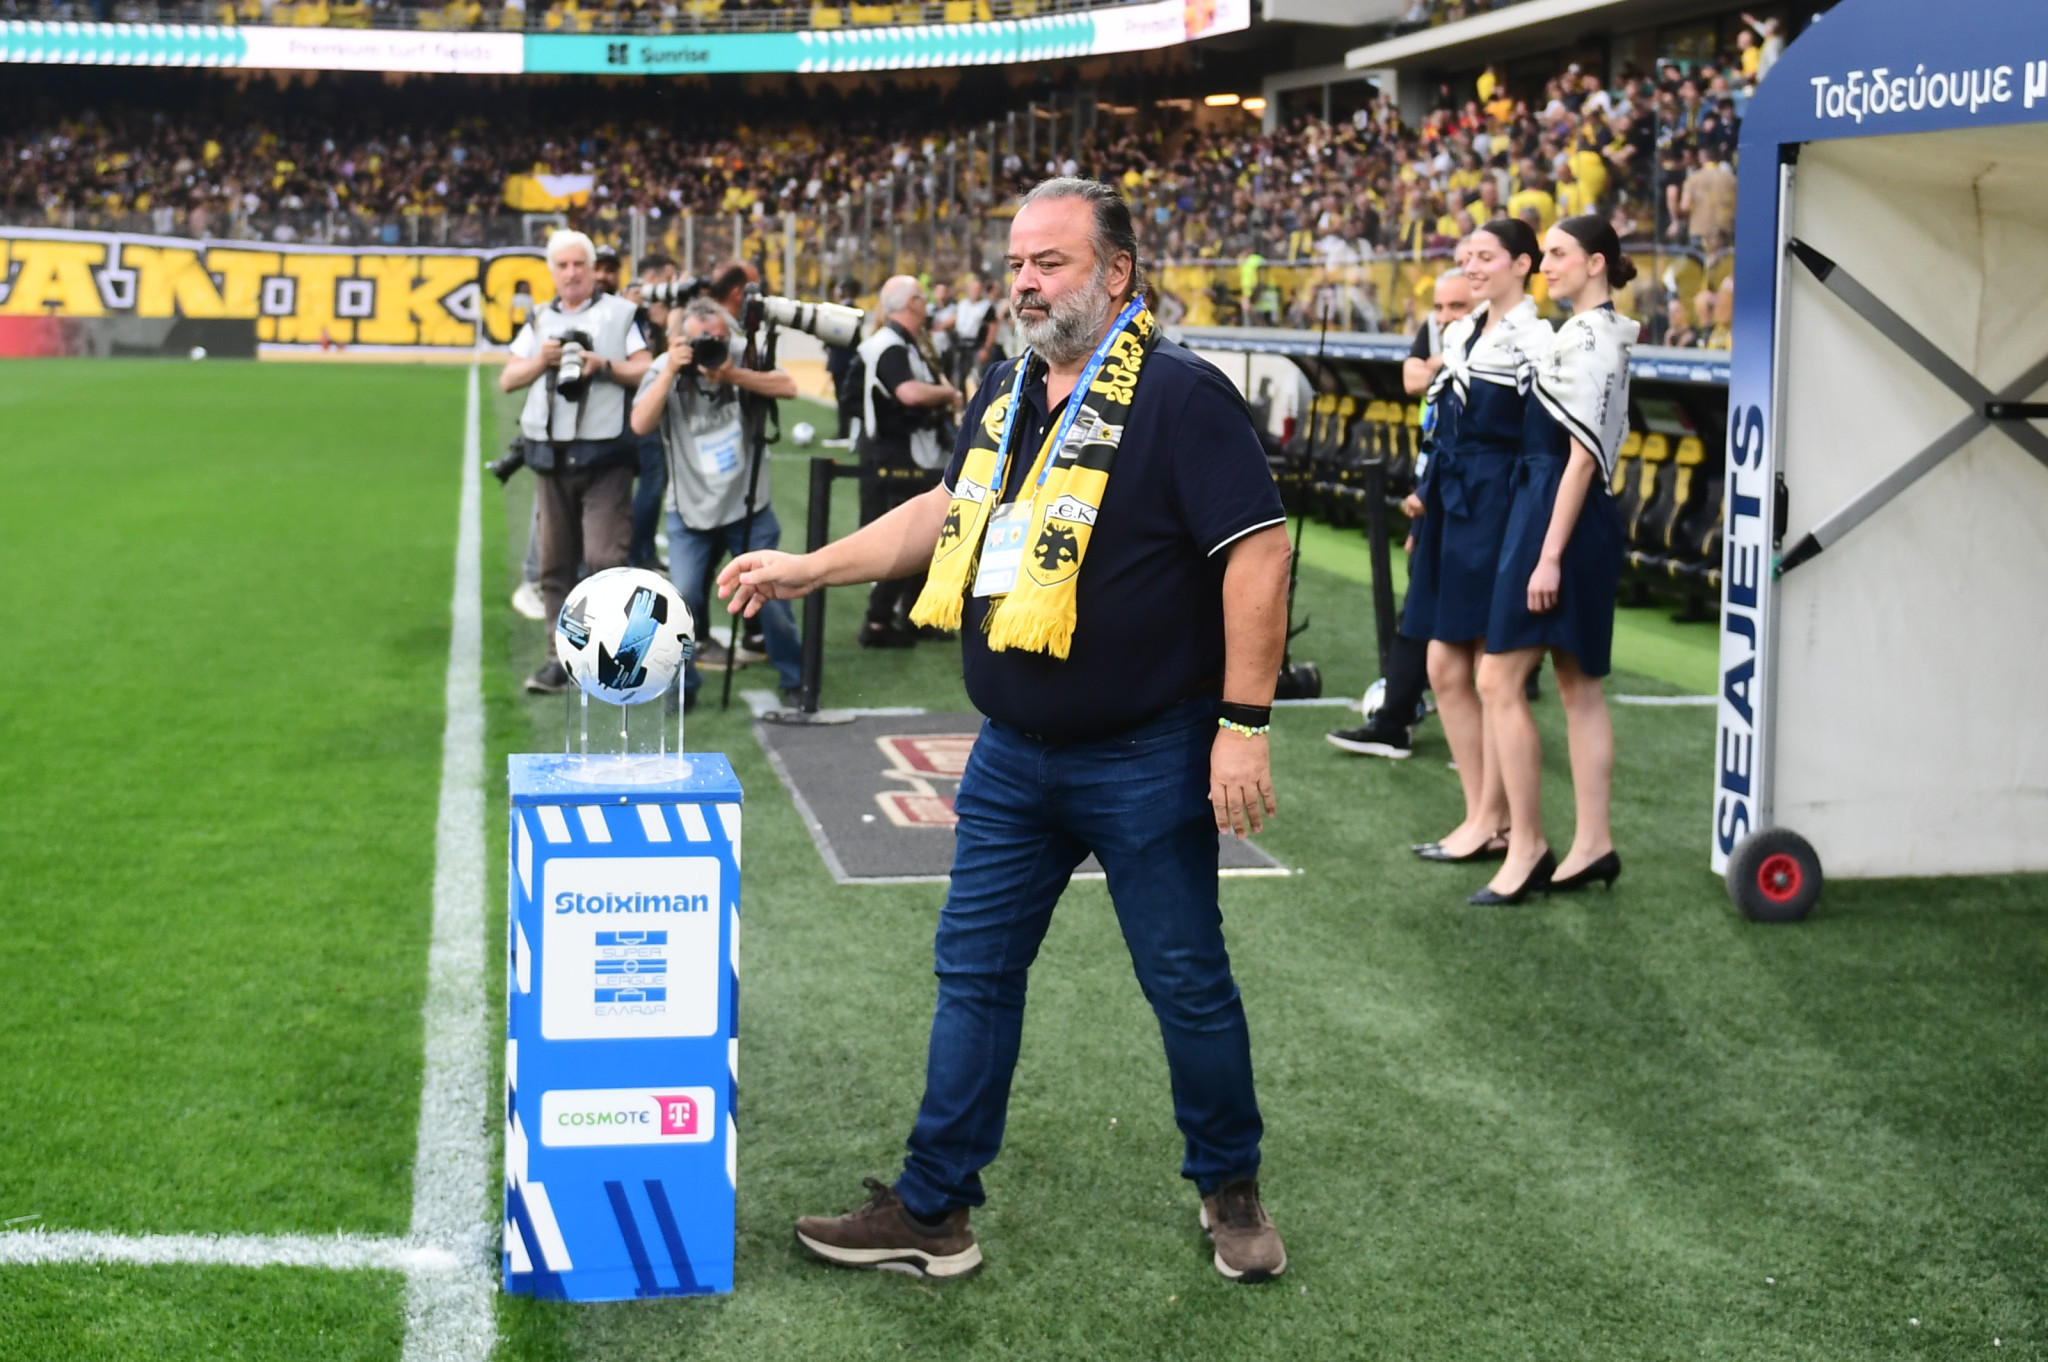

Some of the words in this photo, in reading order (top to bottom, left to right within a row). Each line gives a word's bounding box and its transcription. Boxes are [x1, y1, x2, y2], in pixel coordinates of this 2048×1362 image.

[640, 46, 710, 63] Sunrise
[1810, 63, 2013, 124] Ταξιδεύουμε
[1718, 403, 1765, 857] SEAJETS
[555, 891, 709, 914] Stoiximan
[603, 947, 662, 959] SUPER
[595, 975, 666, 987] LEAGUE
[558, 1111, 650, 1127] COSMOTE
